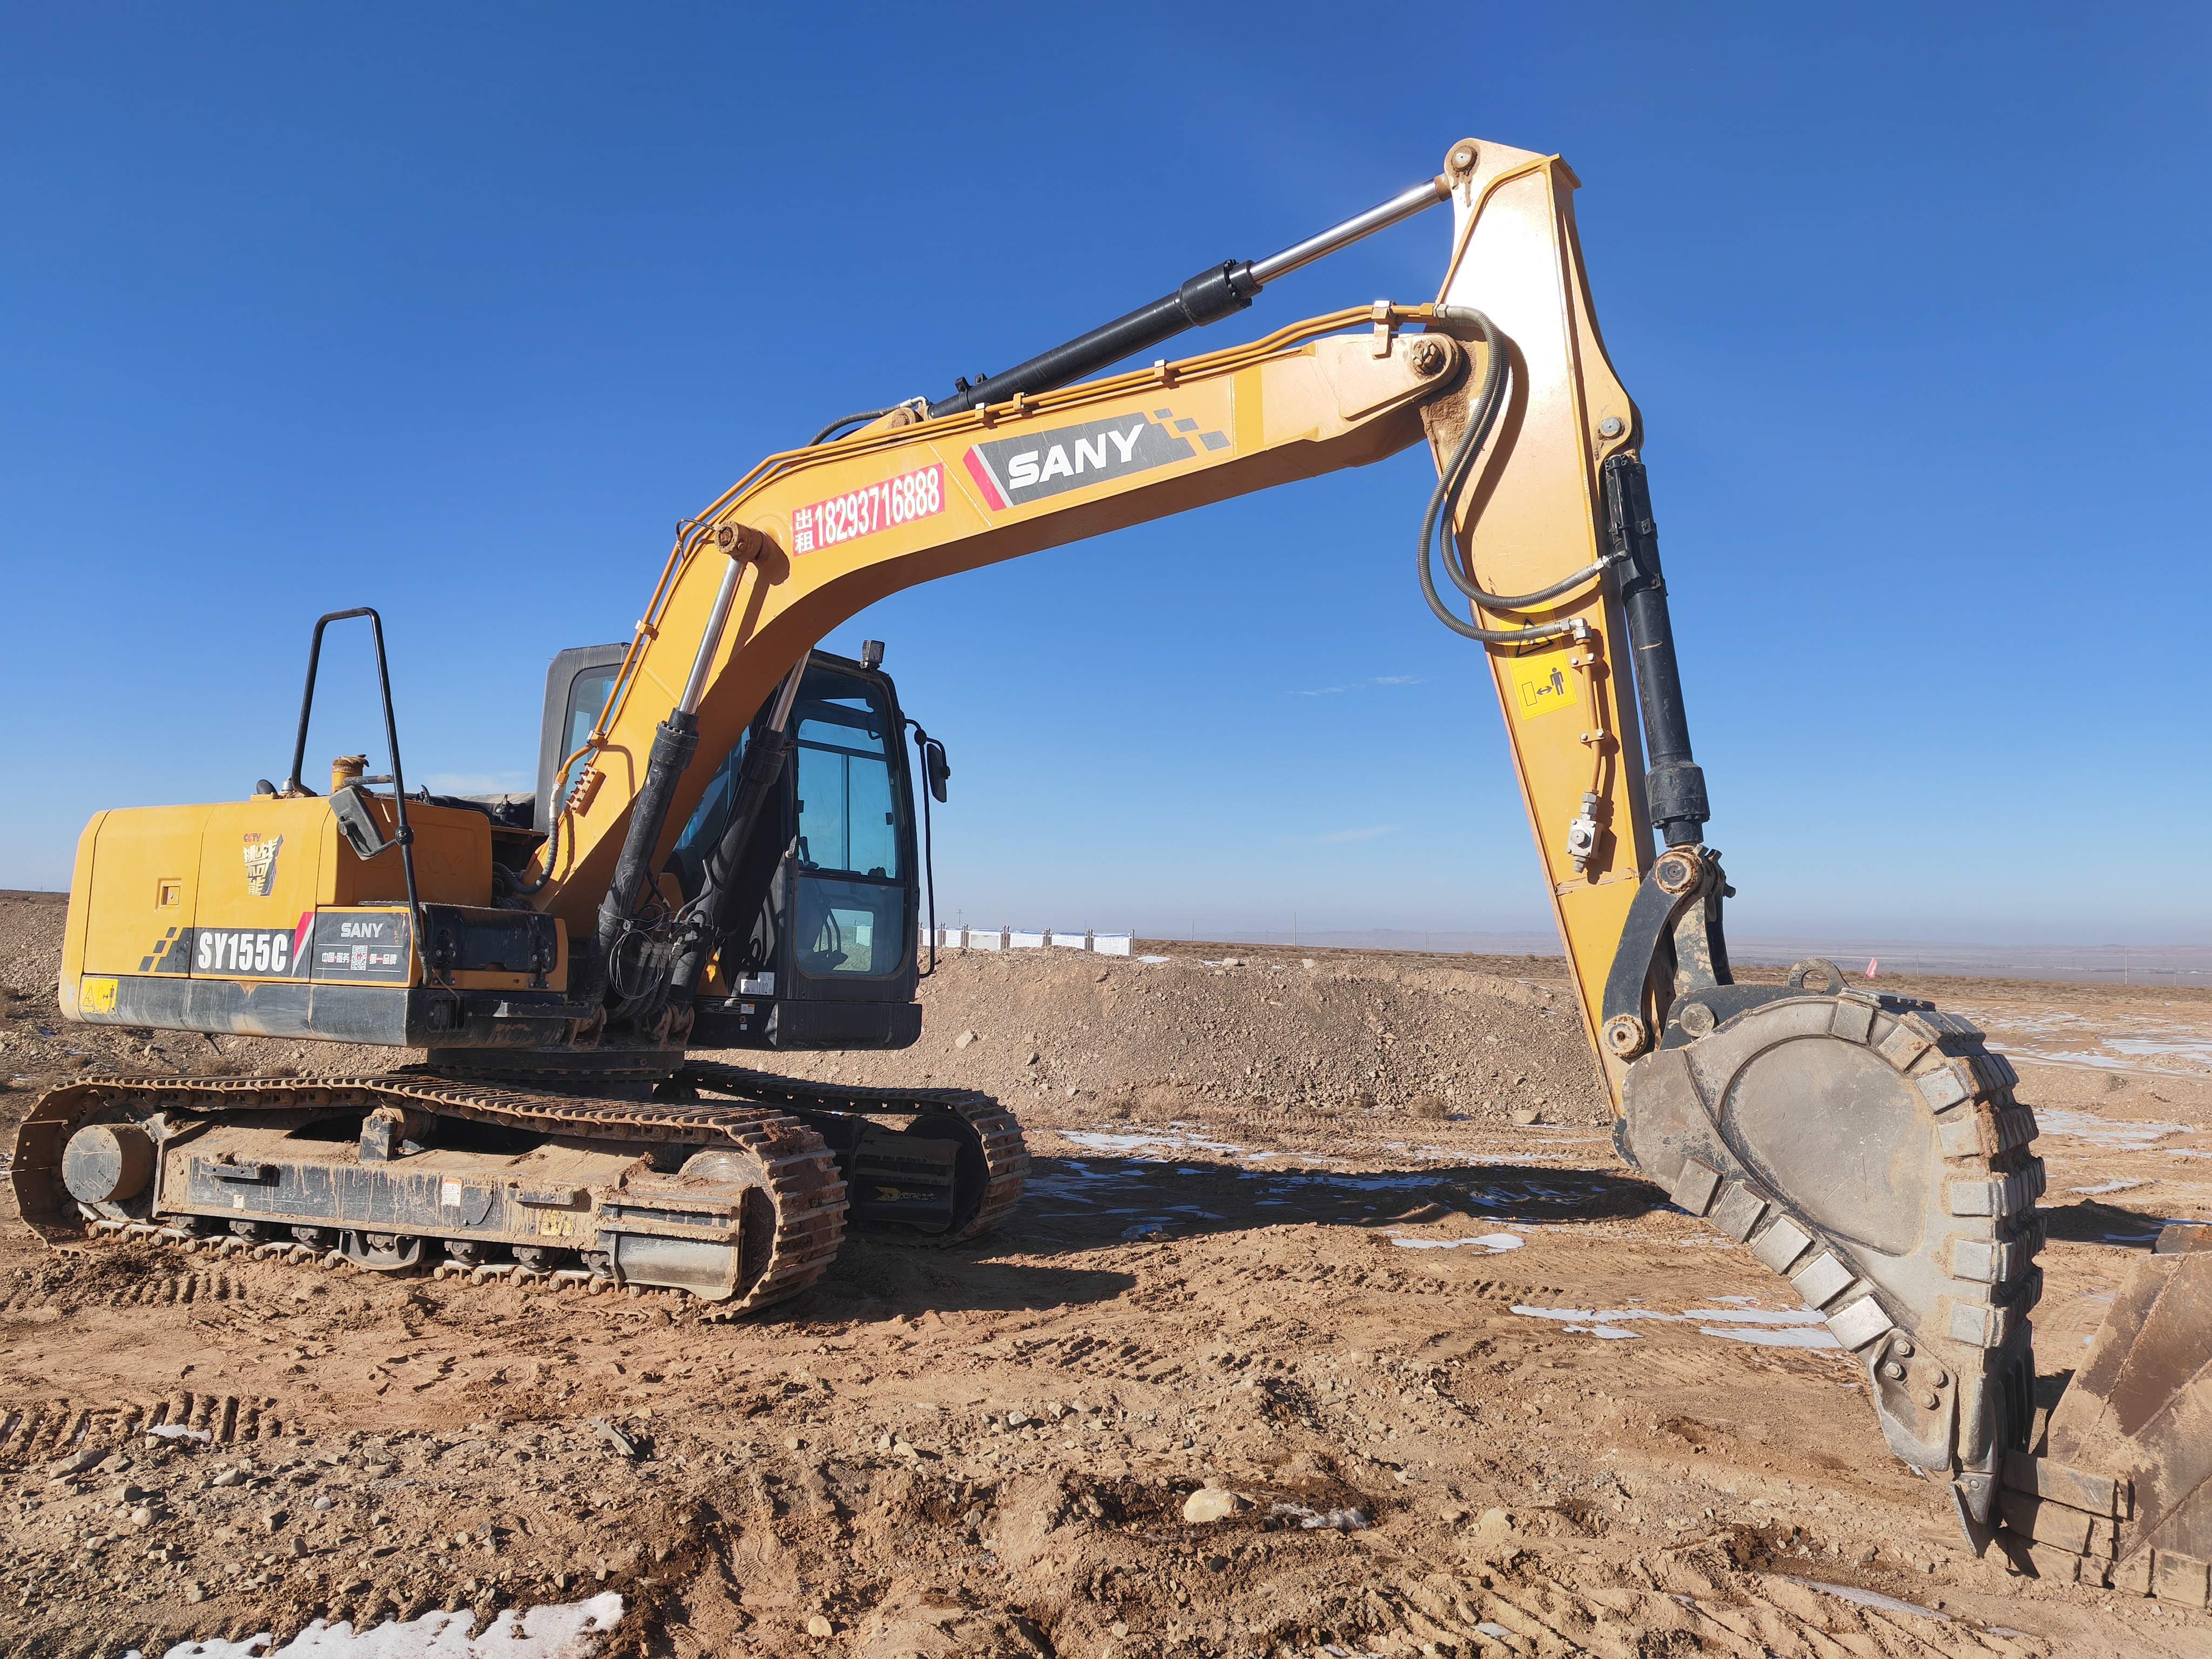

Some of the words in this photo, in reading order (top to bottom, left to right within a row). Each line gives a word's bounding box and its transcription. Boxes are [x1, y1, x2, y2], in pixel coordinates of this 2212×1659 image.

[1008, 423, 1145, 490] SANY
[814, 467, 940, 547] 18293716888
[794, 508, 815, 554] 出租
[243, 833, 262, 842] CCTV
[340, 922, 385, 938] SANY
[198, 932, 287, 973] SY155C
